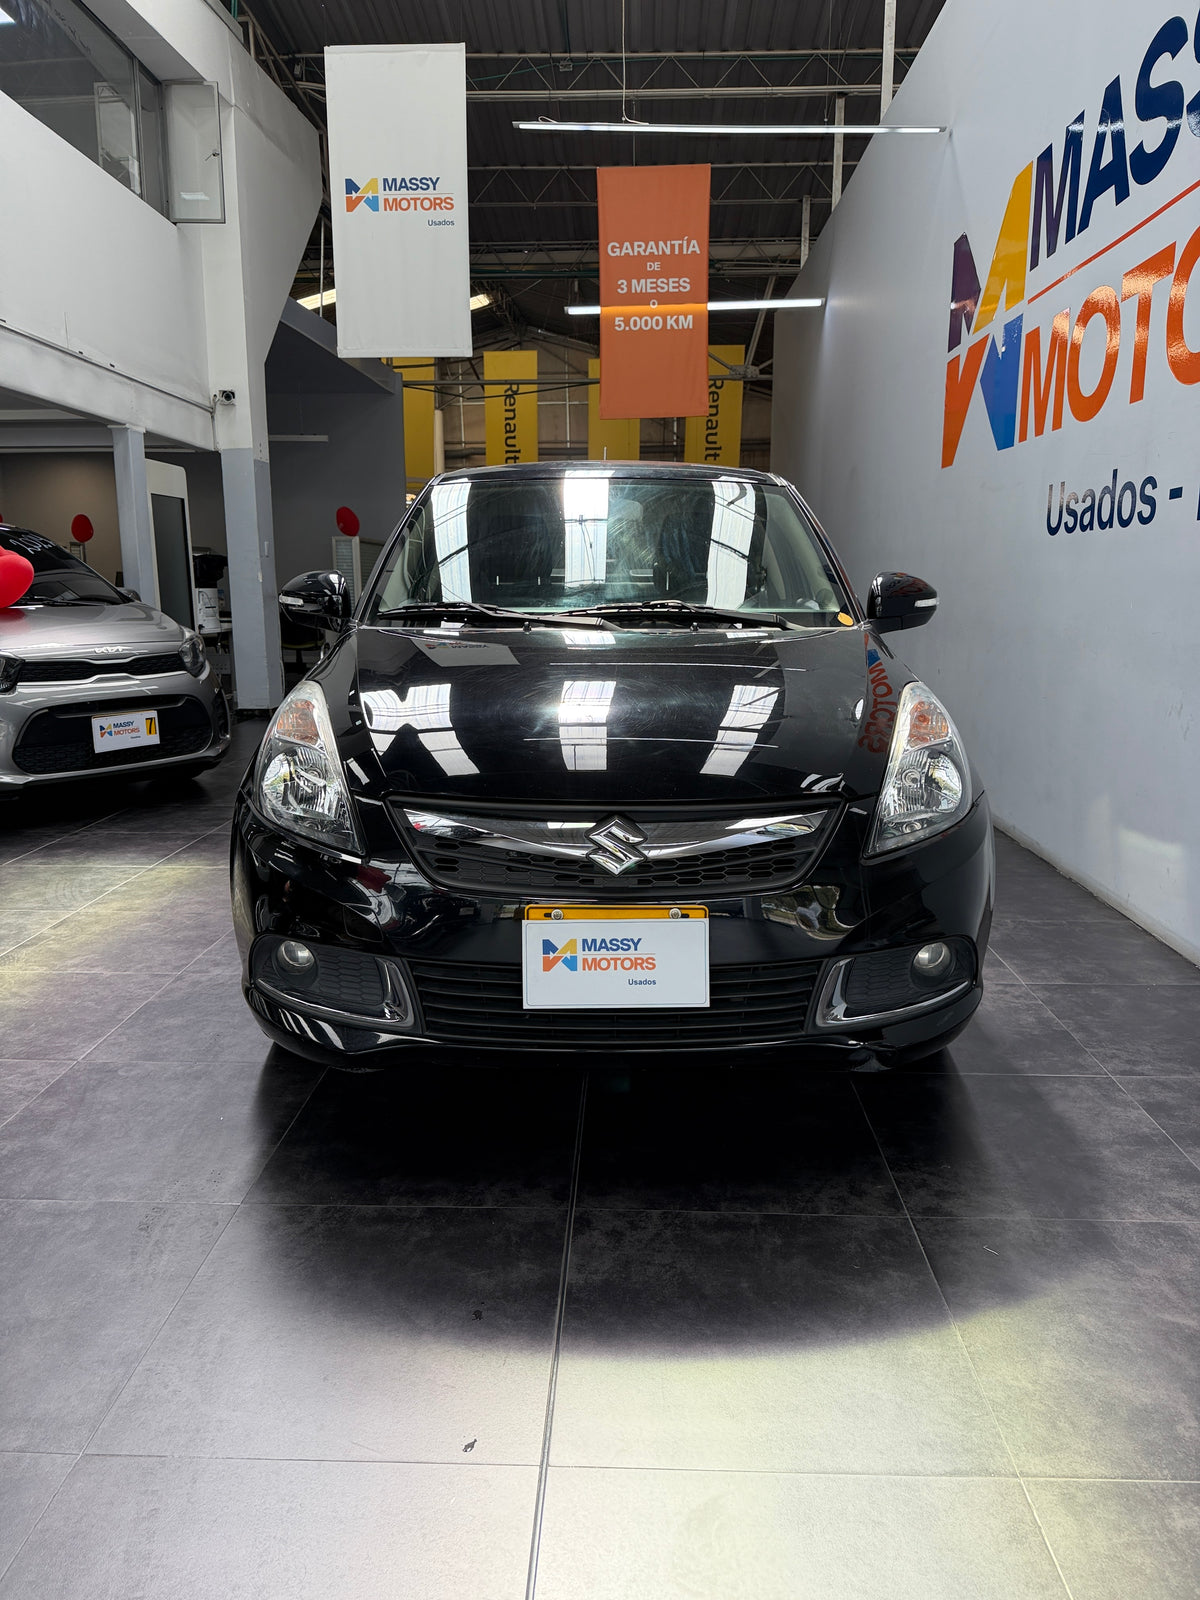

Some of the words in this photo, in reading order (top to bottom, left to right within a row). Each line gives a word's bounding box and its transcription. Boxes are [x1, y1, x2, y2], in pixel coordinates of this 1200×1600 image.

[1029, 8, 1200, 272] MAS
[382, 176, 441, 192] MASSY
[383, 196, 455, 212] MOTORS
[607, 236, 700, 256] GARANTÍA
[646, 262, 661, 271] DE
[617, 280, 628, 294] 3
[631, 278, 691, 293] MESES
[614, 316, 663, 331] 5.000
[666, 315, 693, 329] KM
[503, 383, 521, 464] Renault
[703, 379, 722, 461] Renault
[1046, 468, 1158, 536] Usados
[112, 721, 134, 729] MASSY
[113, 728, 141, 737] MOTORS
[582, 938, 642, 952] MASSY
[582, 957, 657, 971] MOTORS
[628, 978, 657, 986] Usados
